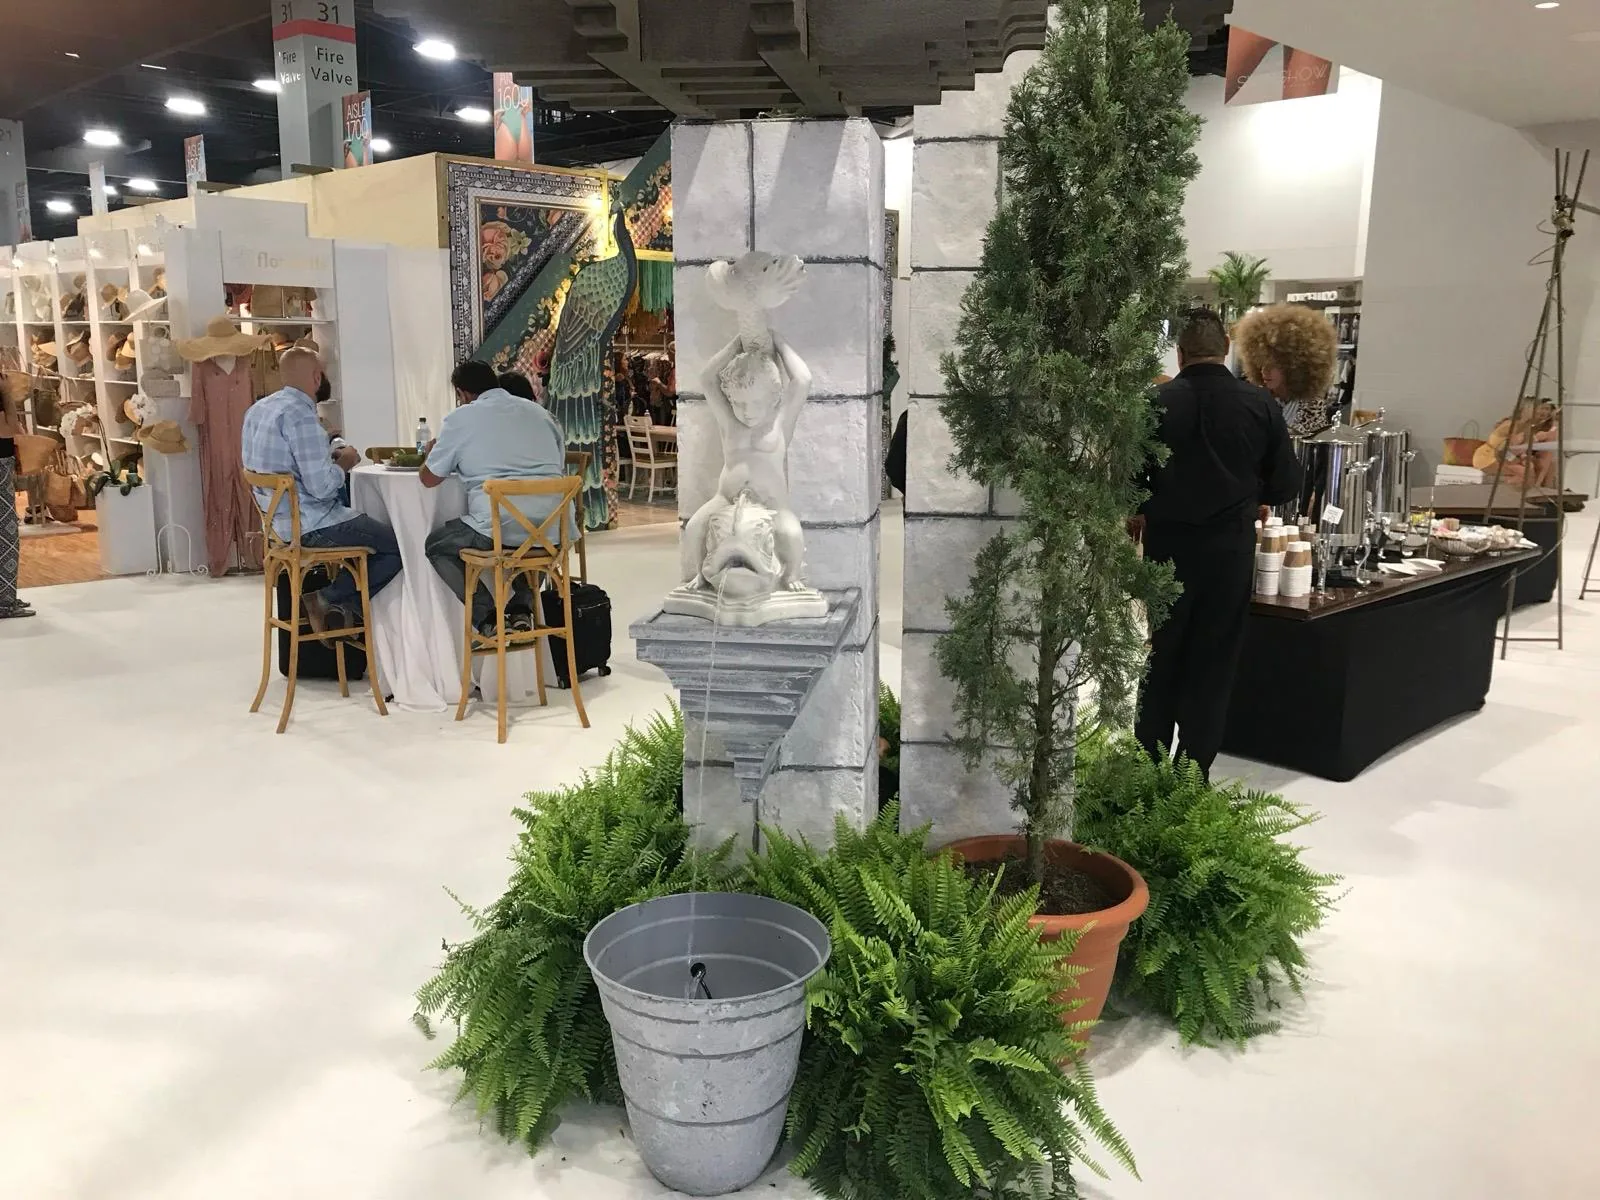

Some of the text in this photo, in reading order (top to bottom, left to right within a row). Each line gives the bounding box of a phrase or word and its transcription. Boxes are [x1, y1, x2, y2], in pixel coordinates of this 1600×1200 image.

[281, 2, 293, 23] 31
[317, 2, 339, 24] 31
[282, 50, 297, 65] Fire
[316, 47, 344, 65] Fire
[280, 71, 303, 85] Valve
[310, 66, 353, 86] Valve
[346, 100, 367, 121] AISLE
[346, 117, 369, 142] 1700
